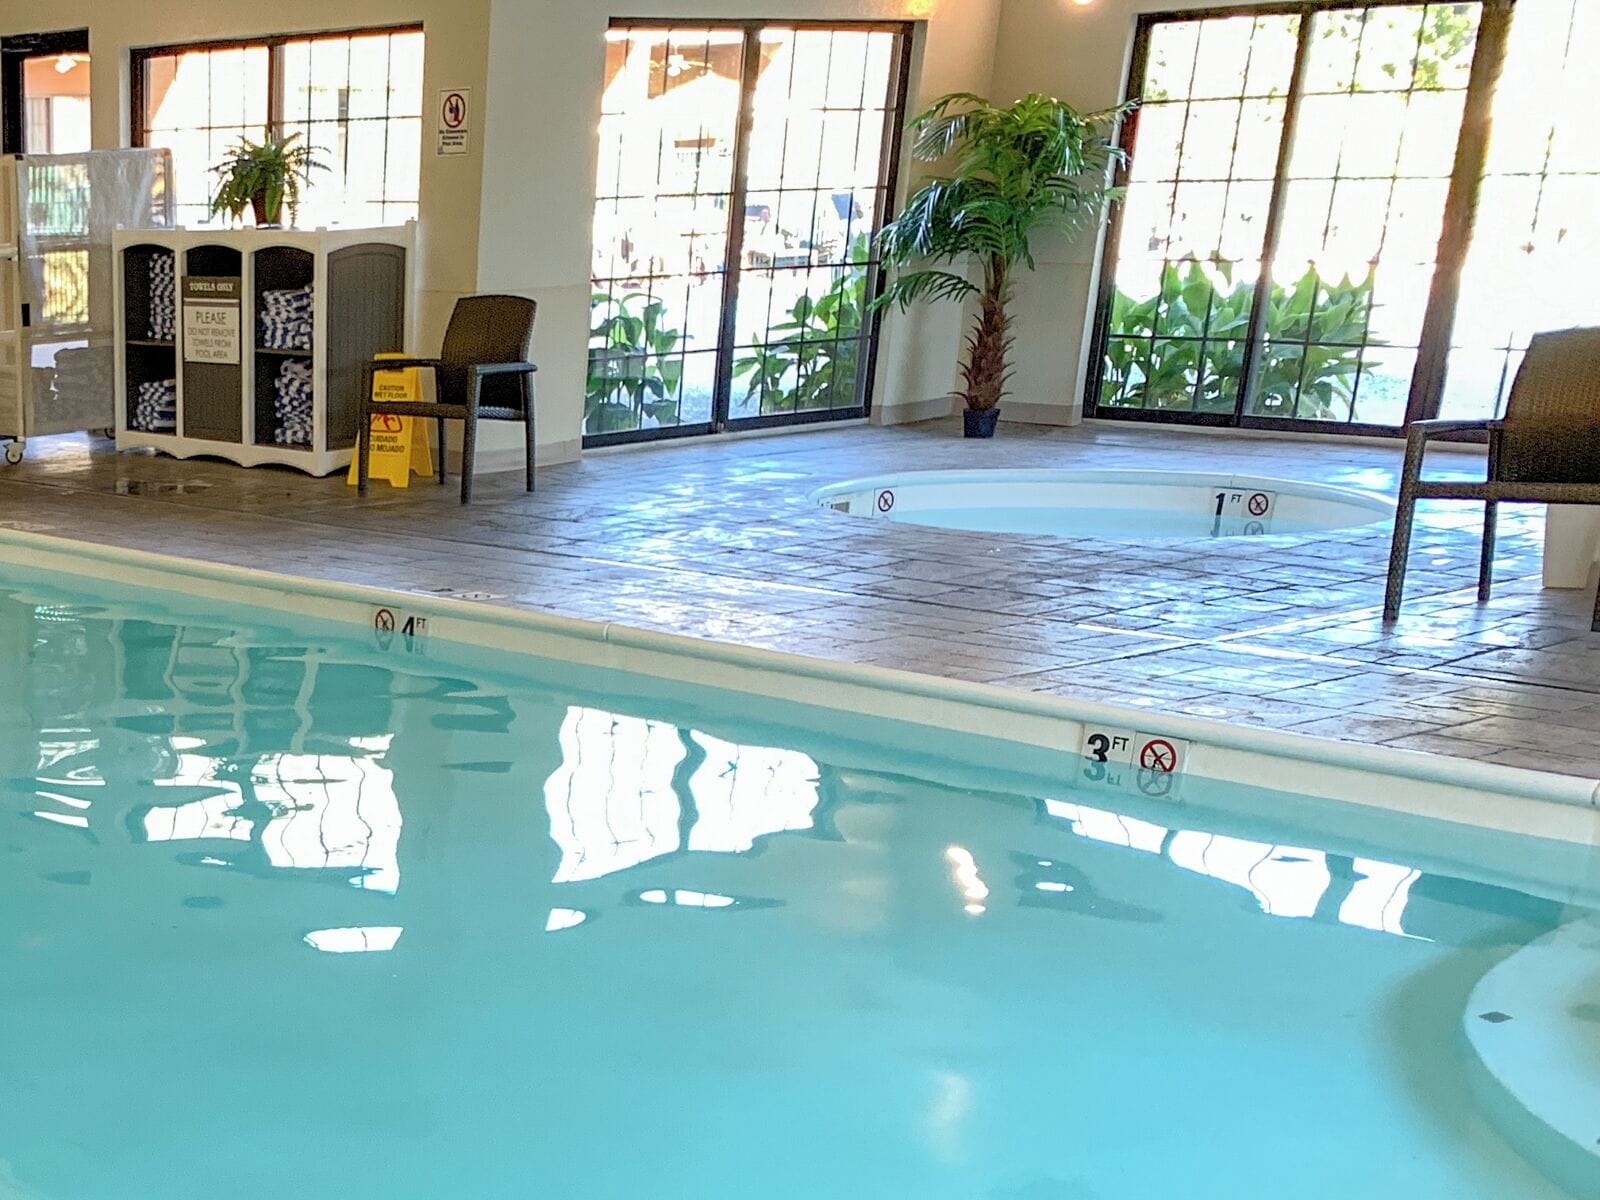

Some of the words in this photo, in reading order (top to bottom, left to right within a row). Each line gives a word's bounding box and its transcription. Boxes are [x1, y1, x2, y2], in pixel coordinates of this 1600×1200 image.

[196, 312, 227, 325] PLEASE
[1216, 493, 1225, 515] 1
[1231, 494, 1242, 503] FT
[416, 617, 426, 629] FT
[1087, 734, 1110, 762] 3
[1112, 736, 1129, 751] FT
